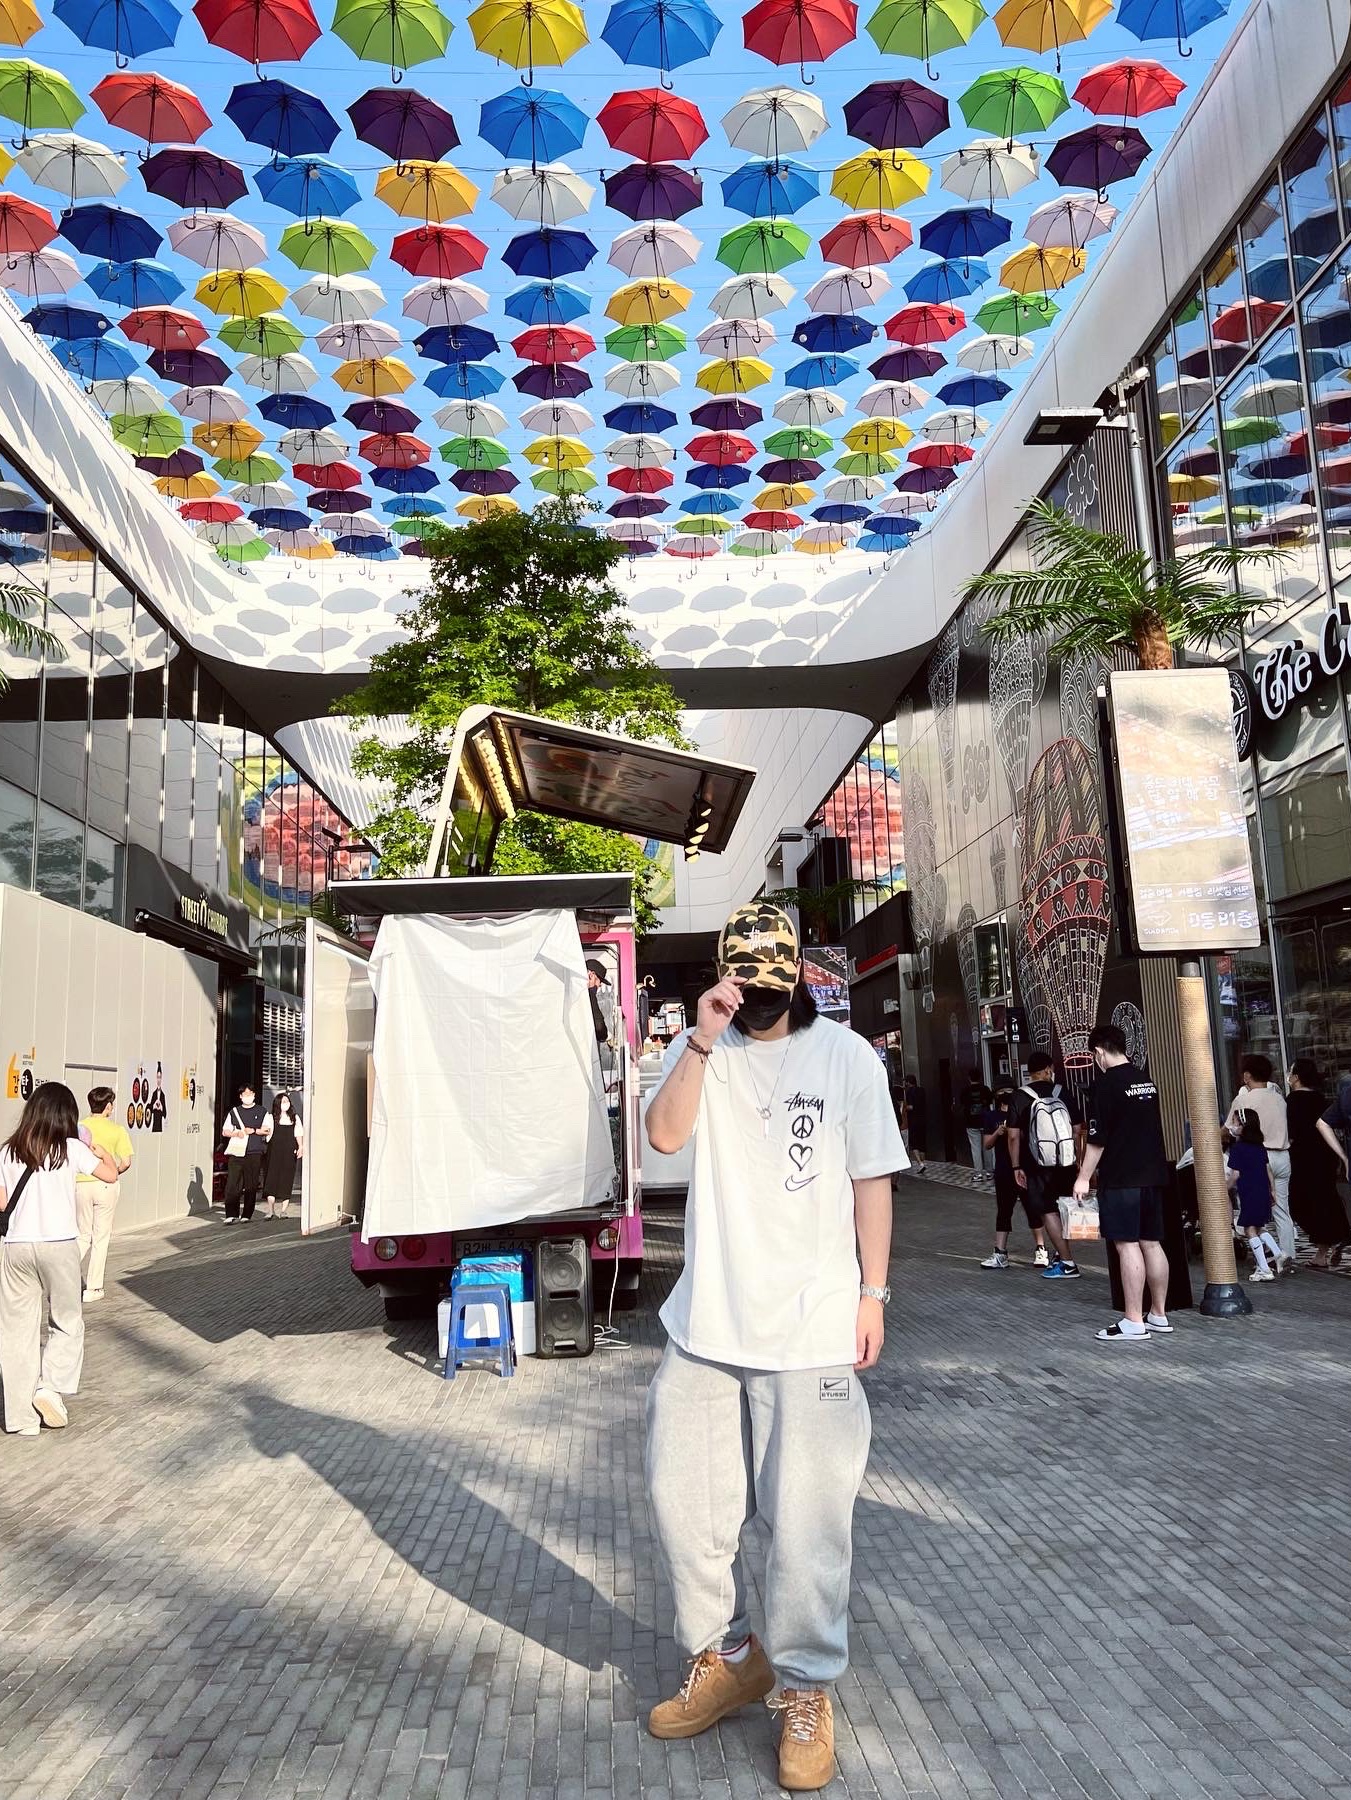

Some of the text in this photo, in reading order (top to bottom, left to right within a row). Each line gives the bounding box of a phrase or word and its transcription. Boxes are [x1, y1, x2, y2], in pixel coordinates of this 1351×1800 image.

[1253, 608, 1351, 720] The C
[180, 895, 200, 924] STREET
